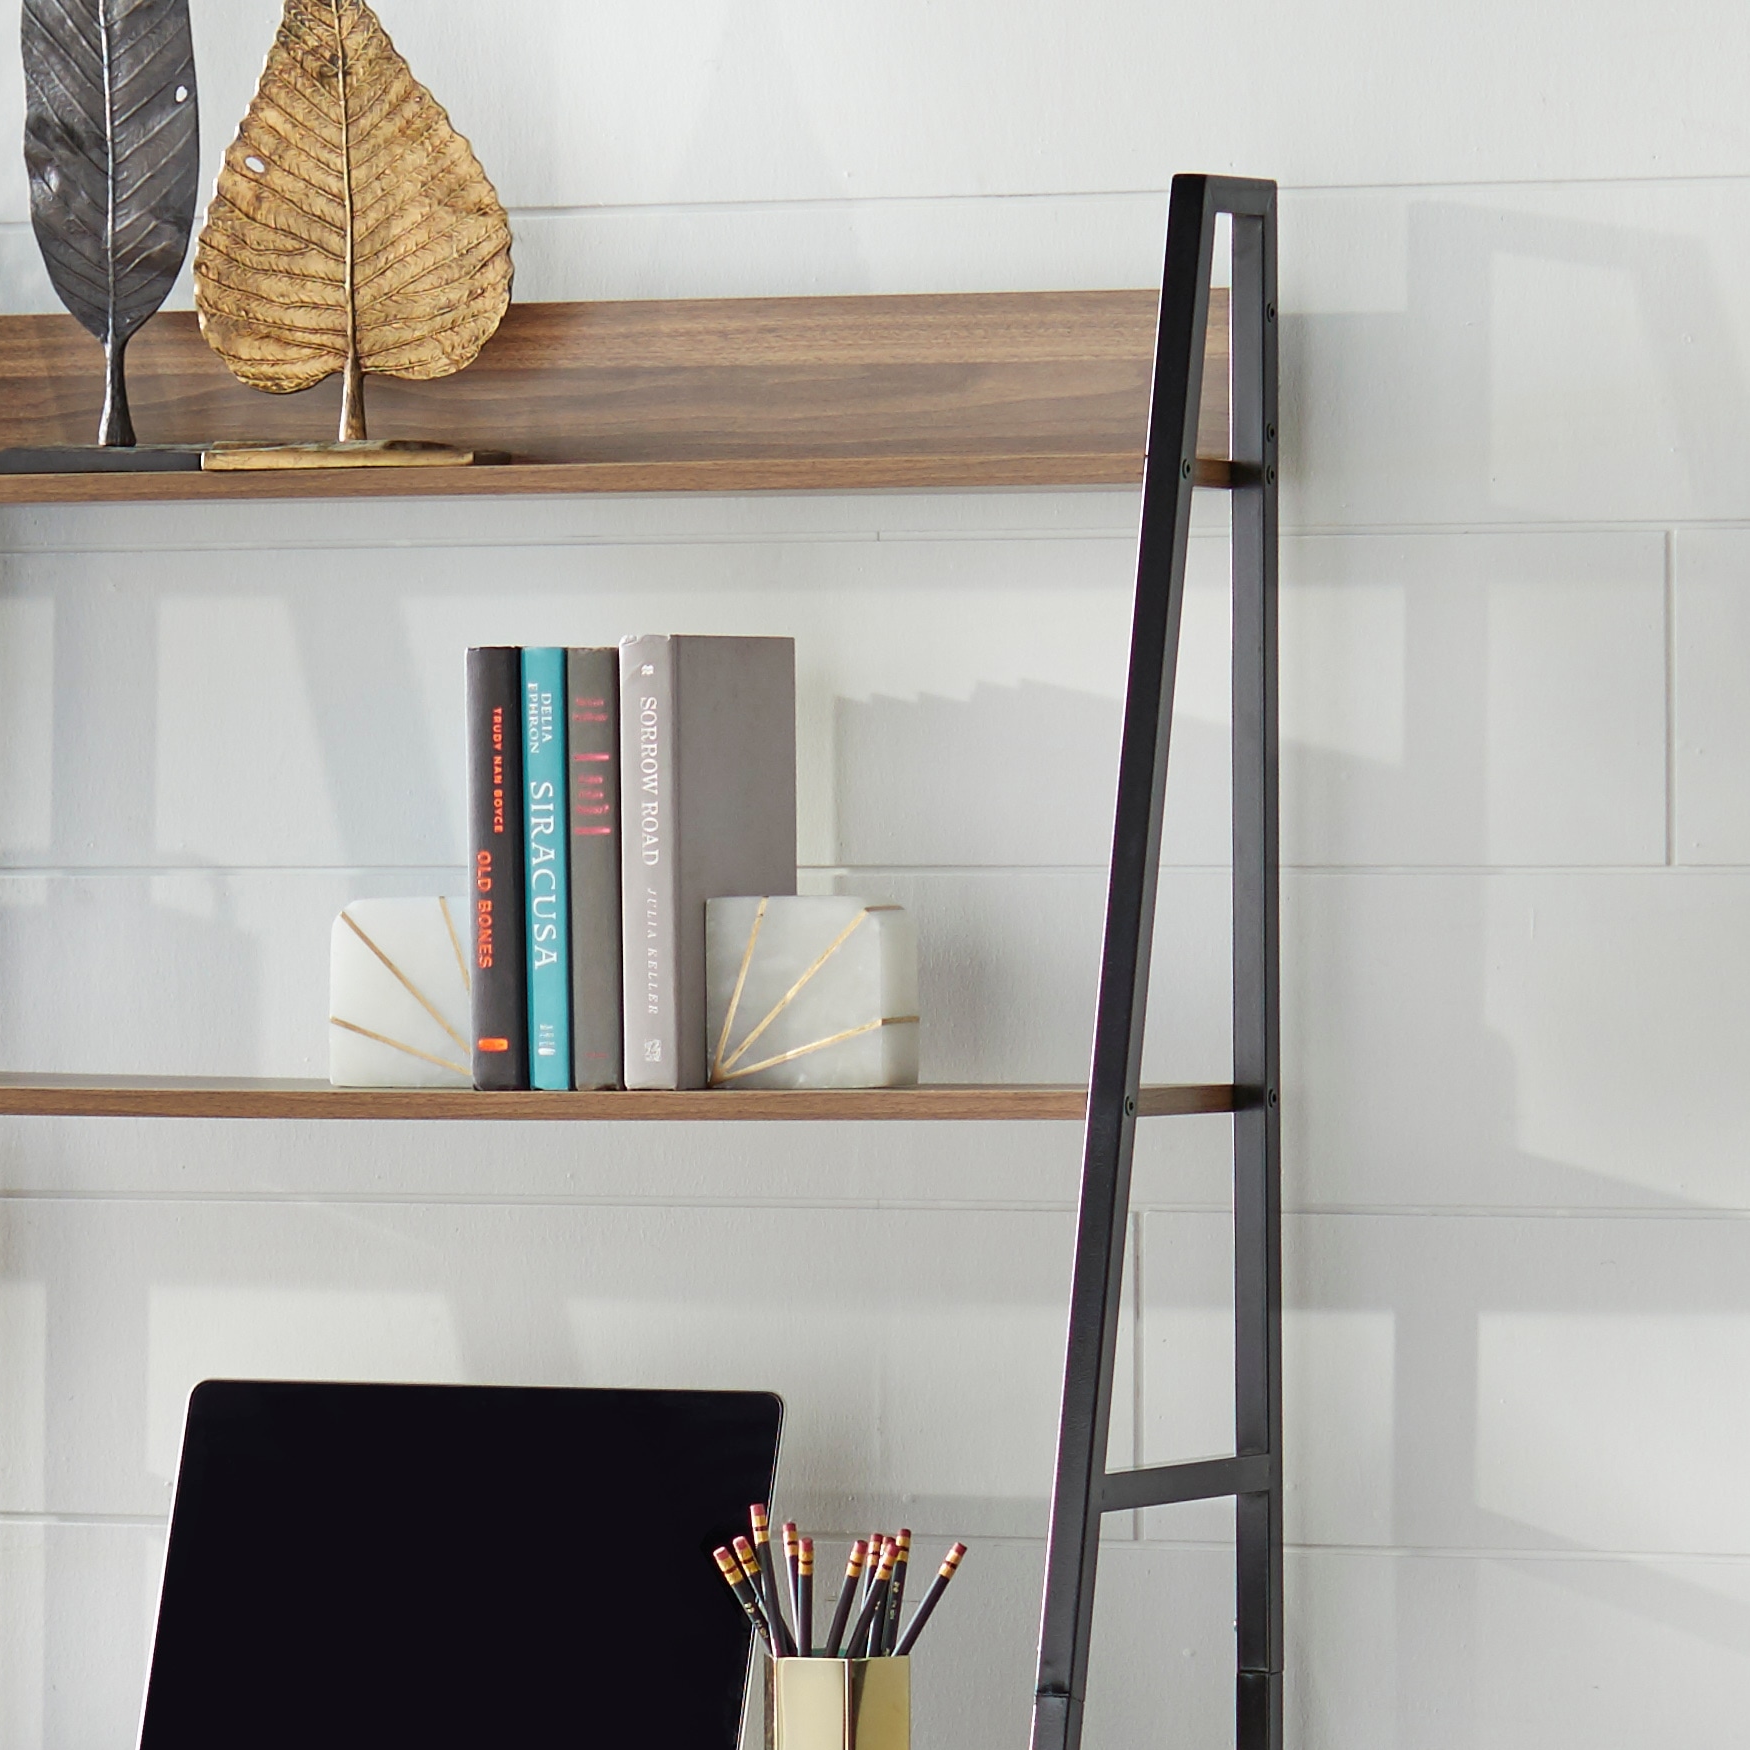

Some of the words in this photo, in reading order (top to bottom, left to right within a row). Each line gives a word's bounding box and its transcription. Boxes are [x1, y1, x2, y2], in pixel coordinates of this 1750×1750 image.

[527, 682, 539, 754] EPHRON
[540, 693, 553, 743] DELIA
[640, 697, 659, 796] SORROW
[641, 801, 659, 865] ROAD
[477, 849, 492, 892] OLD
[530, 782, 557, 970] SIRACUSA
[478, 900, 493, 969] BONES
[647, 888, 657, 938] JULIA
[648, 948, 659, 1014] KELLER
